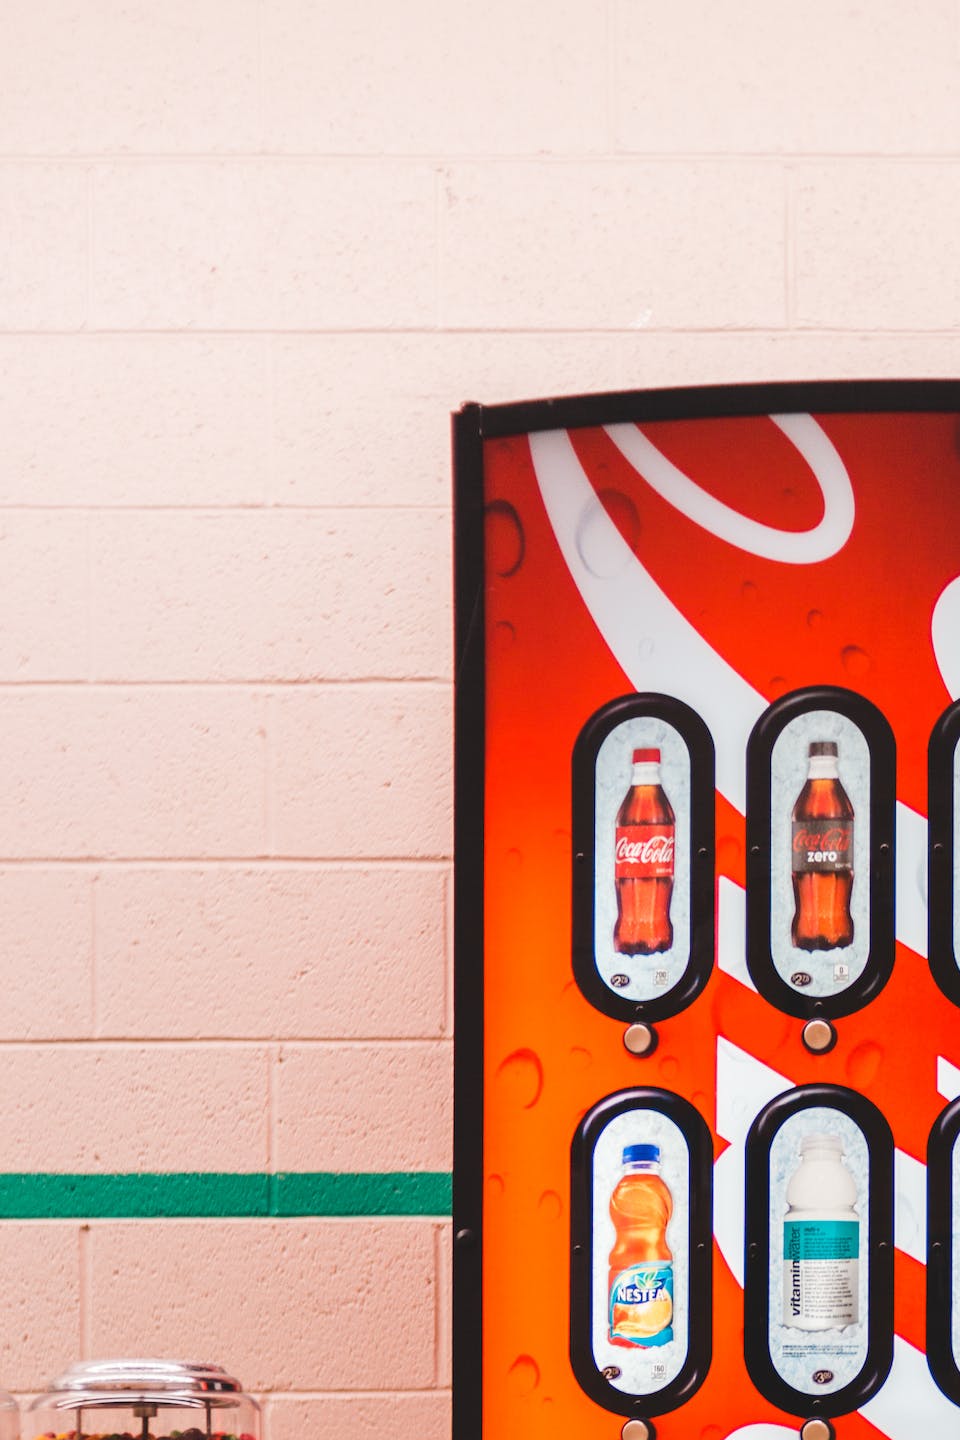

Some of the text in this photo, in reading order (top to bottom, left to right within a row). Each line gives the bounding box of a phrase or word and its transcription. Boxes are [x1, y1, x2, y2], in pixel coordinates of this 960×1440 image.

[616, 836, 673, 864] Coca-Cola
[807, 851, 837, 862] zero
[790, 1227, 800, 1316] vitaminwater
[618, 1288, 664, 1302] NESTEA
